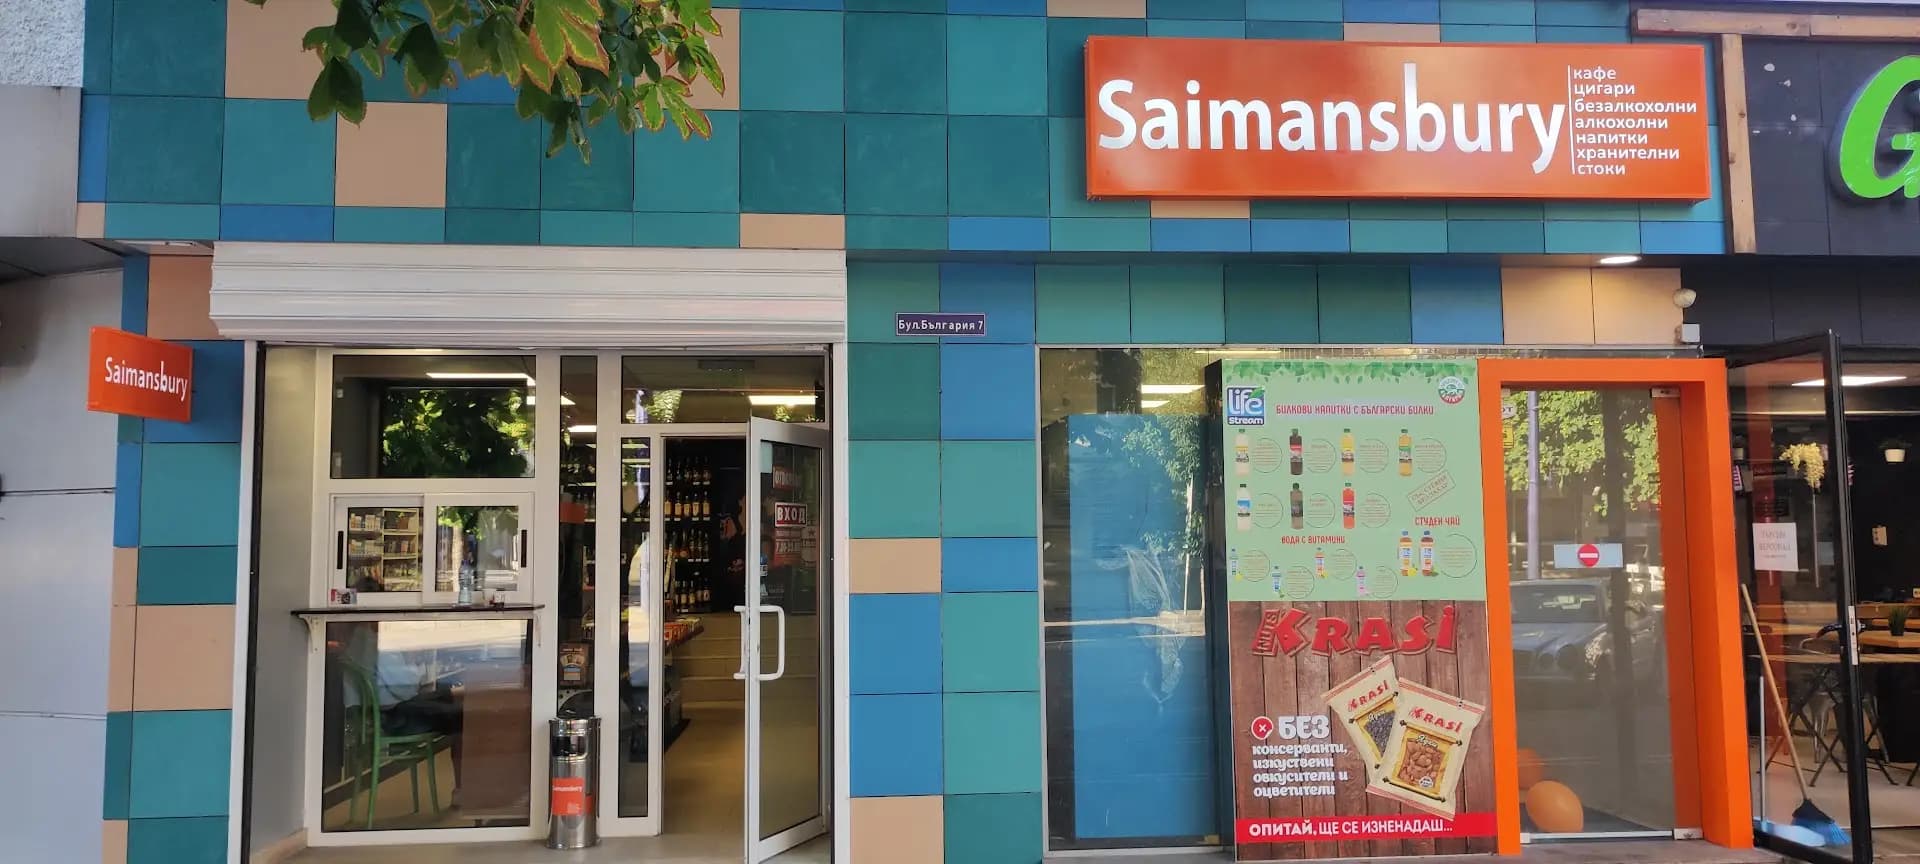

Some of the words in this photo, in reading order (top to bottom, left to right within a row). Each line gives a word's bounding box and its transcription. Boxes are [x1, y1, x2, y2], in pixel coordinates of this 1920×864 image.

[1573, 66, 1617, 82] кафе
[1574, 83, 1636, 97] цигари
[1574, 98, 1697, 113] безалкохолни
[1098, 63, 1566, 174] Saimansbury
[1575, 117, 1668, 129] алкохолни
[1576, 133, 1648, 144] напитки
[1576, 148, 1680, 161] хранителни
[1577, 163, 1626, 175] стоки
[978, 320, 984, 330] 7
[105, 356, 189, 402] Saimansbury
[776, 506, 806, 524] ВХОД
[1278, 715, 1330, 740] БЕЗ
[1252, 743, 1348, 757] консерванти,
[1252, 757, 1335, 772] изкуствени
[1253, 771, 1336, 786] овкусители
[1338, 771, 1349, 781] и
[1253, 785, 1336, 799] оцветители
[1249, 819, 1317, 837] ОПИТАЙ,
[1318, 822, 1339, 835] ЩЕ
[1341, 821, 1359, 834] СЕ
